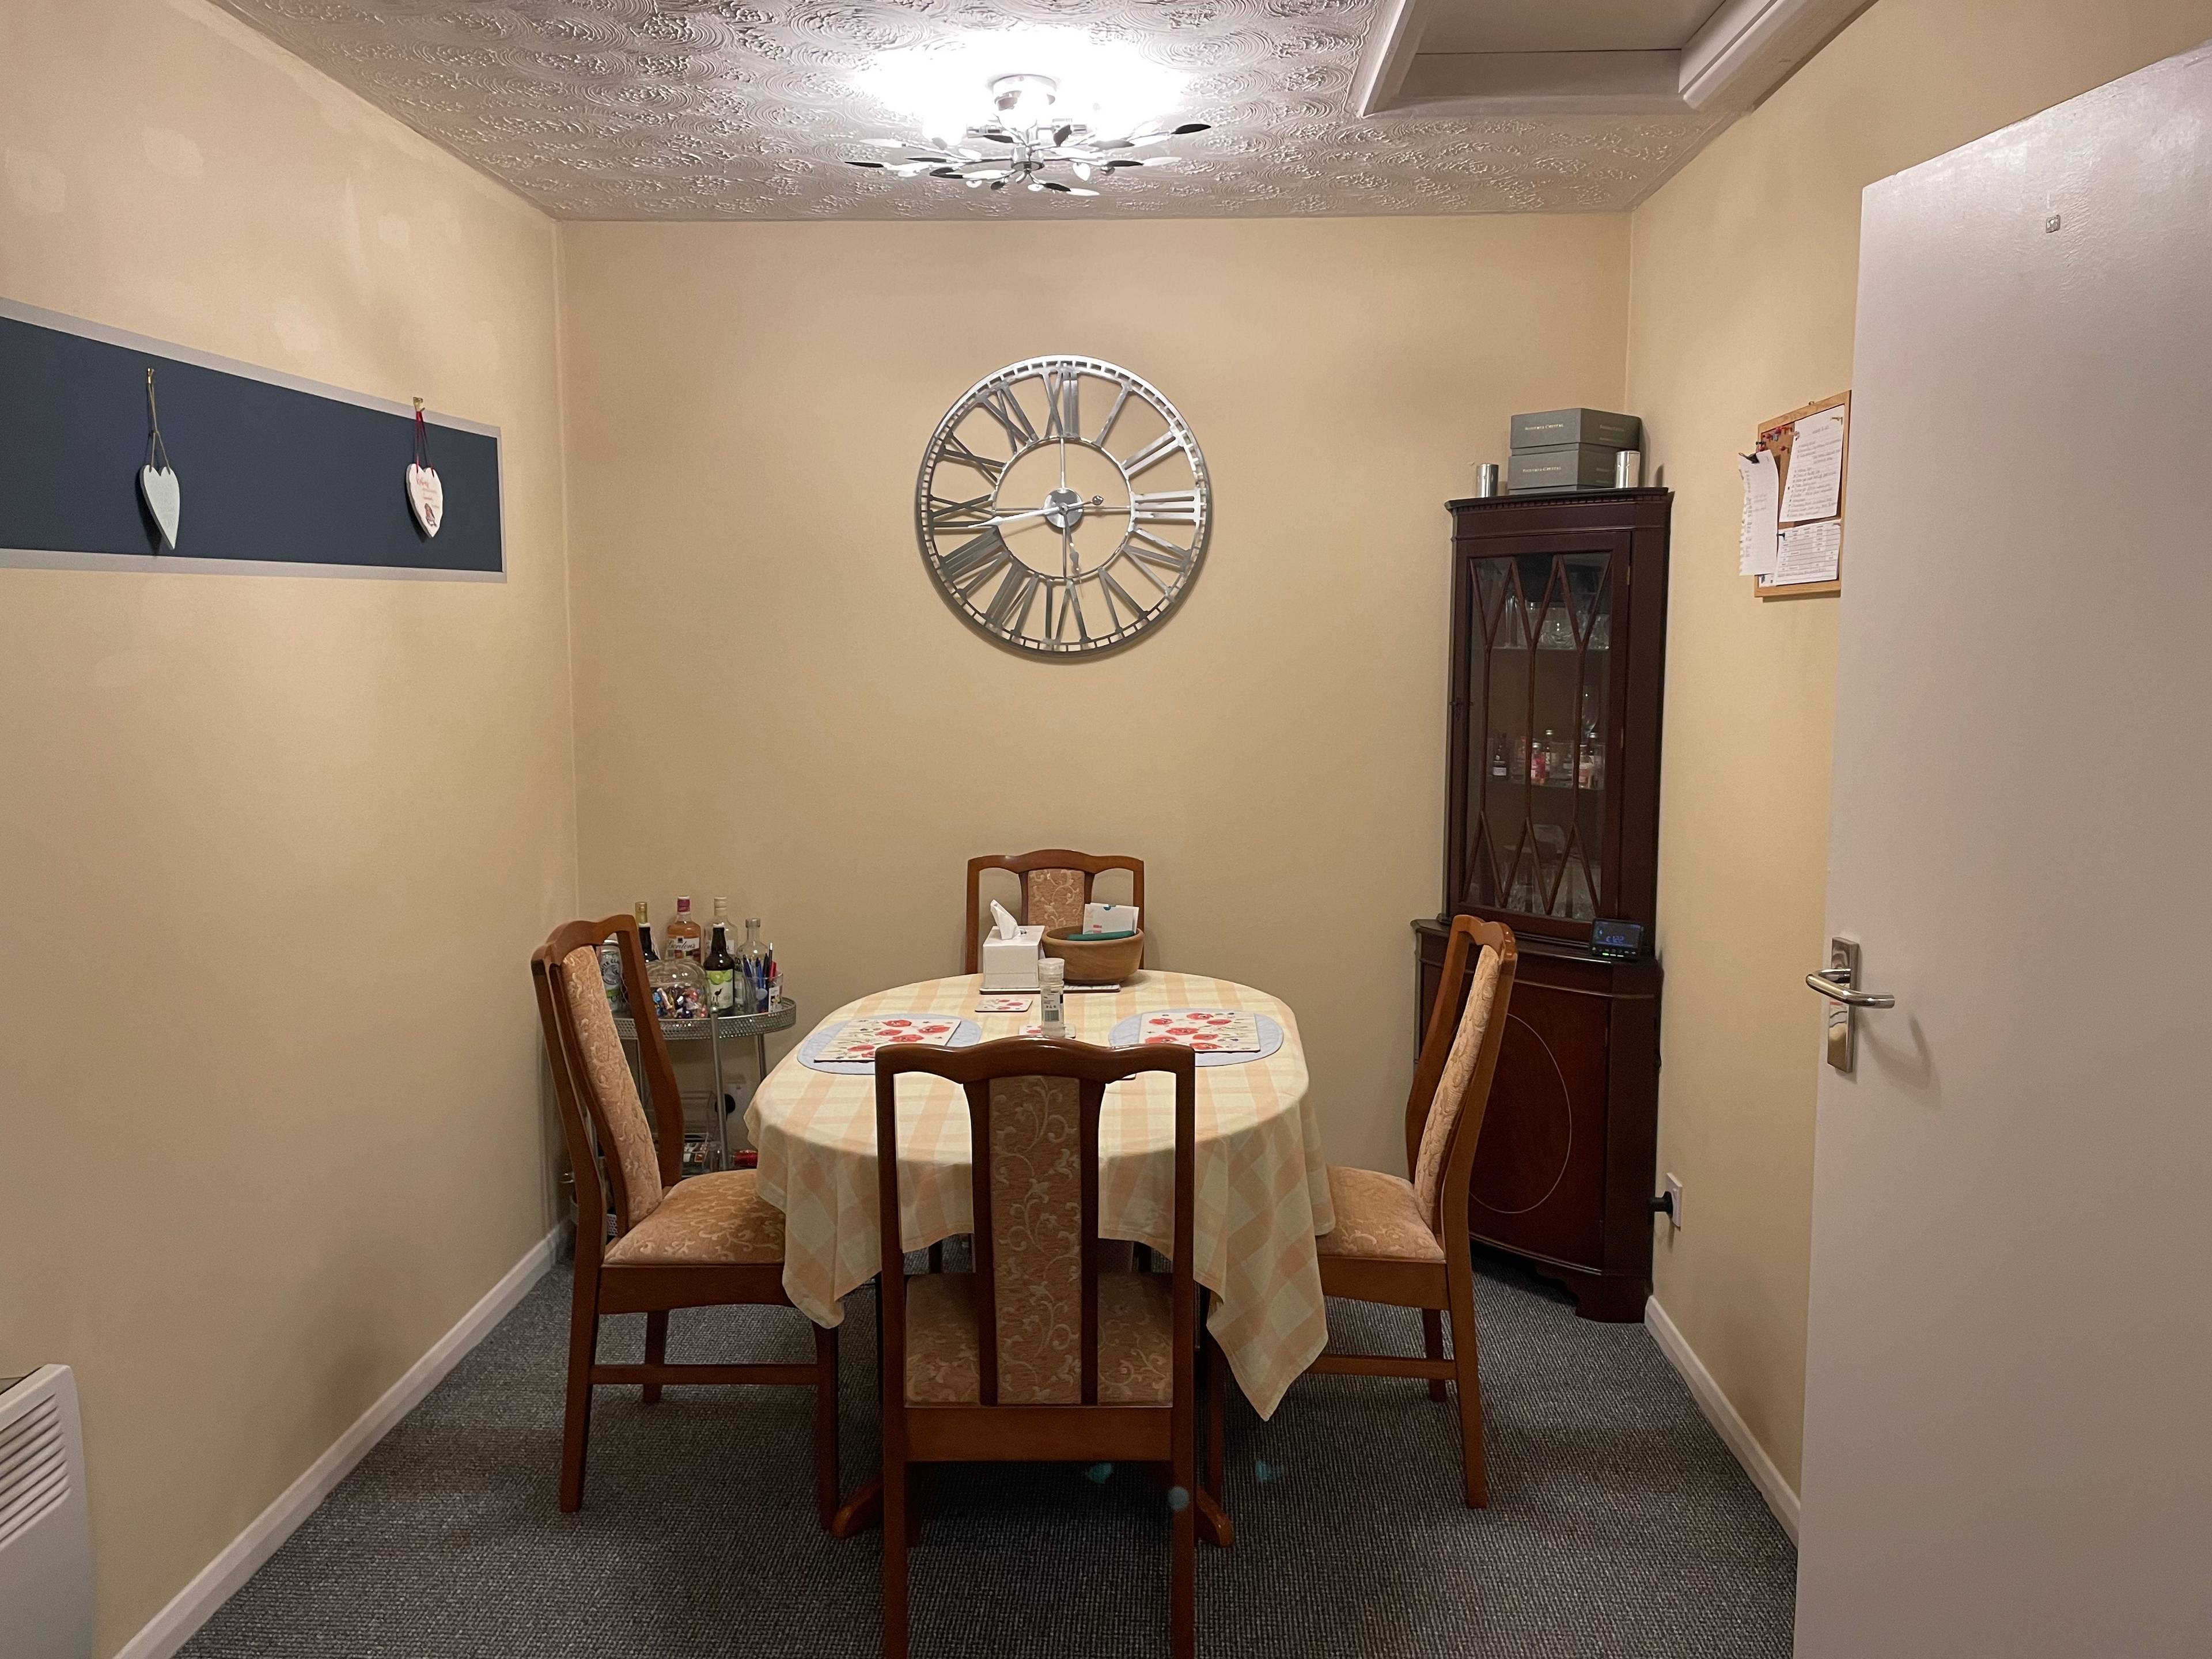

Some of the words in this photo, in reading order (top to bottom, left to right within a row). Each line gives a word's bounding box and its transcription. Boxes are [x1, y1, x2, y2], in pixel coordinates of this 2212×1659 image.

[975, 381, 1039, 454] XI
[1041, 369, 1080, 438] XII
[1093, 382, 1132, 447] I
[937, 431, 1006, 485] X
[1123, 425, 1185, 479] II
[1131, 488, 1200, 522] III
[937, 525, 1011, 600] VIII
[1122, 524, 1192, 597] IV
[982, 561, 1040, 637] VII
[1046, 578, 1093, 642] VI
[1098, 567, 1148, 634] V
